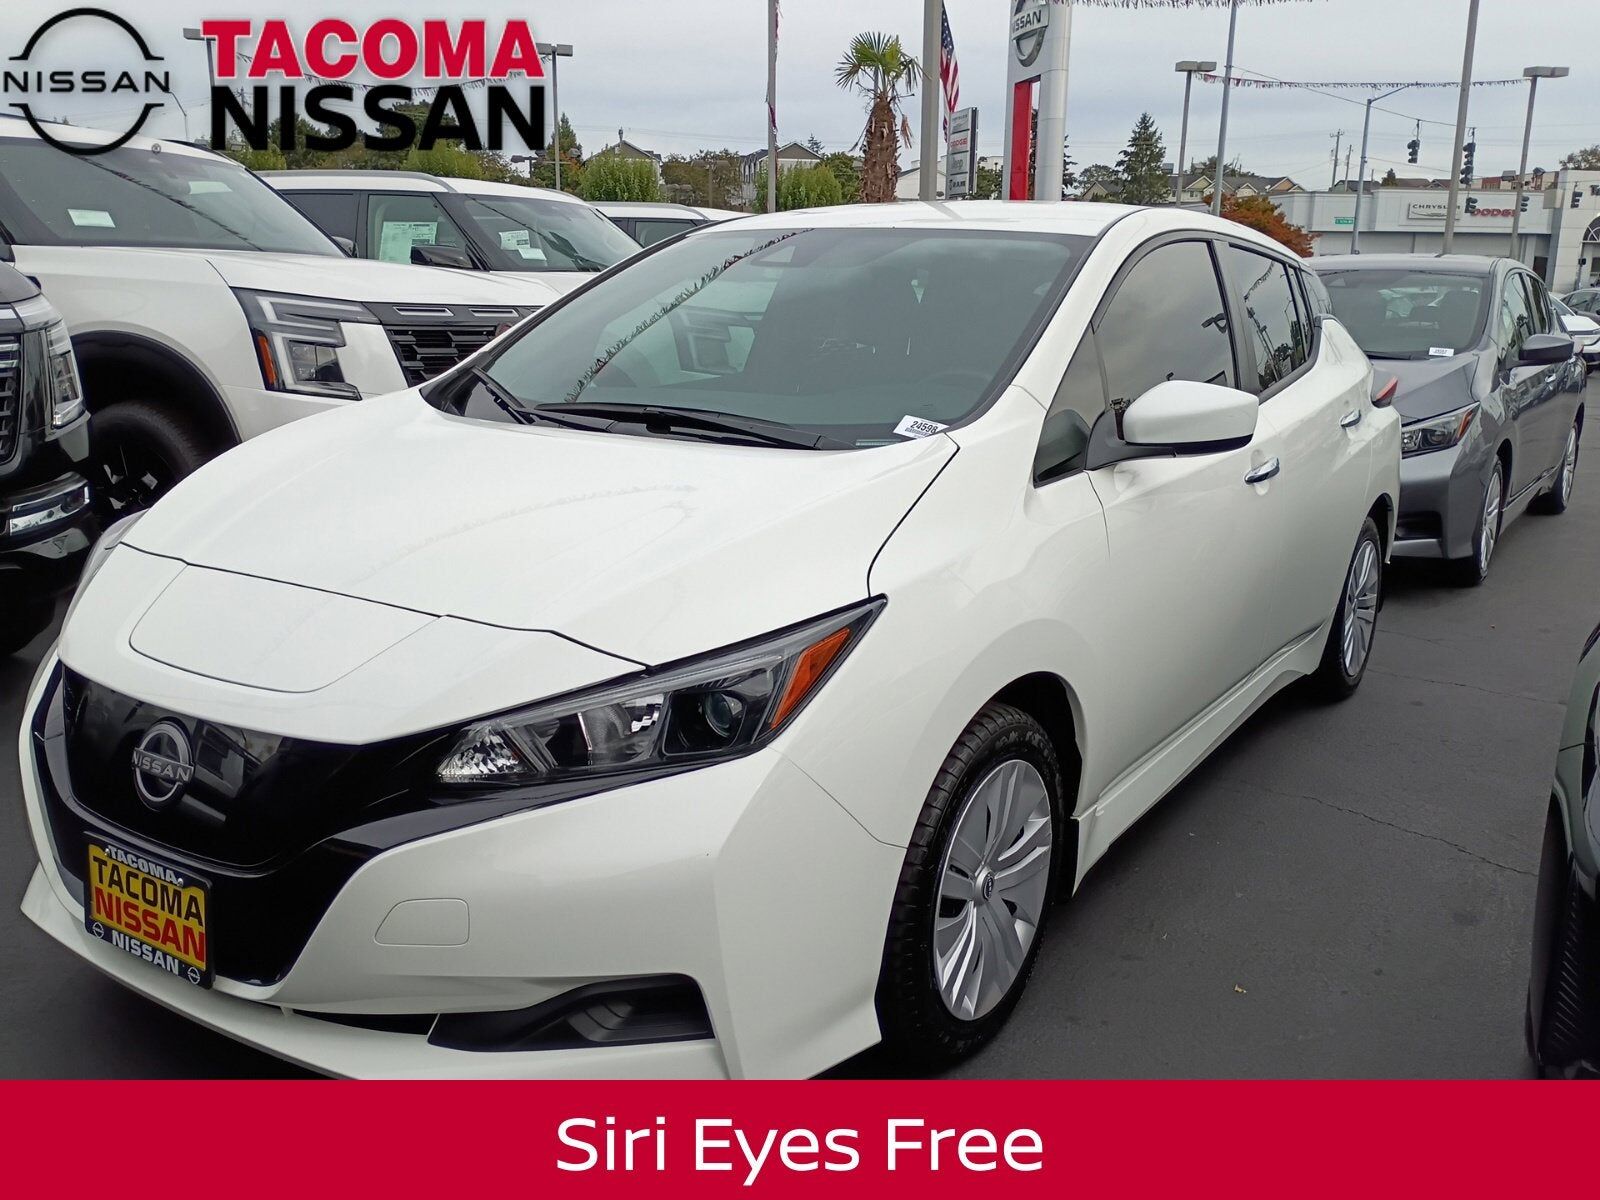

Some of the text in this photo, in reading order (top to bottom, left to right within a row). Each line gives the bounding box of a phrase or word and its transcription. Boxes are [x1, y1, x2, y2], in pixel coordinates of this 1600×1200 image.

[1011, 9, 1042, 33] ISSAN
[132, 750, 191, 782] NISSAN
[107, 844, 178, 884] TACOMA
[93, 855, 204, 927] TACOMA
[94, 886, 206, 963] NISSAN
[111, 929, 179, 976] NISSAN
